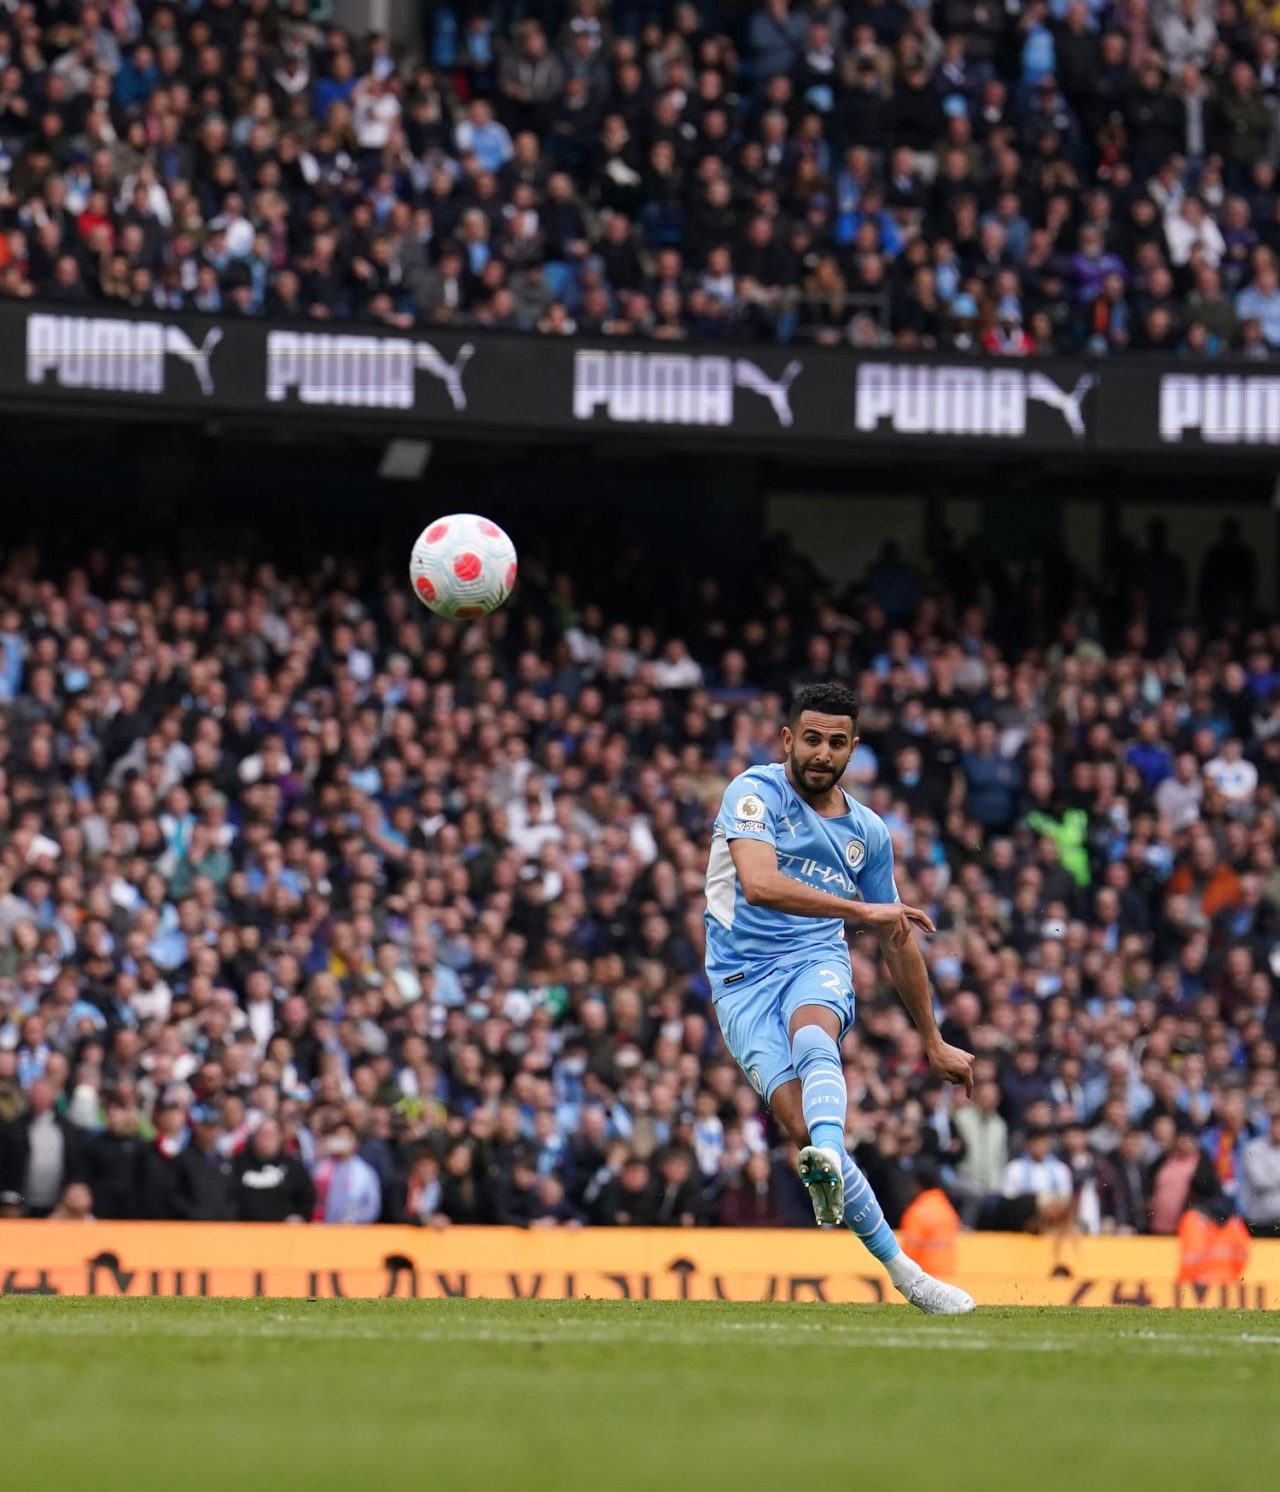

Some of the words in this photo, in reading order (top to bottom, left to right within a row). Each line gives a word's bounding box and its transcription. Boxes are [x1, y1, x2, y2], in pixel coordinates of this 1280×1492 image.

[26, 313, 165, 394] PUMA
[265, 330, 415, 410] PUMA
[573, 349, 733, 426] PUMA
[855, 361, 1026, 437] PUMA
